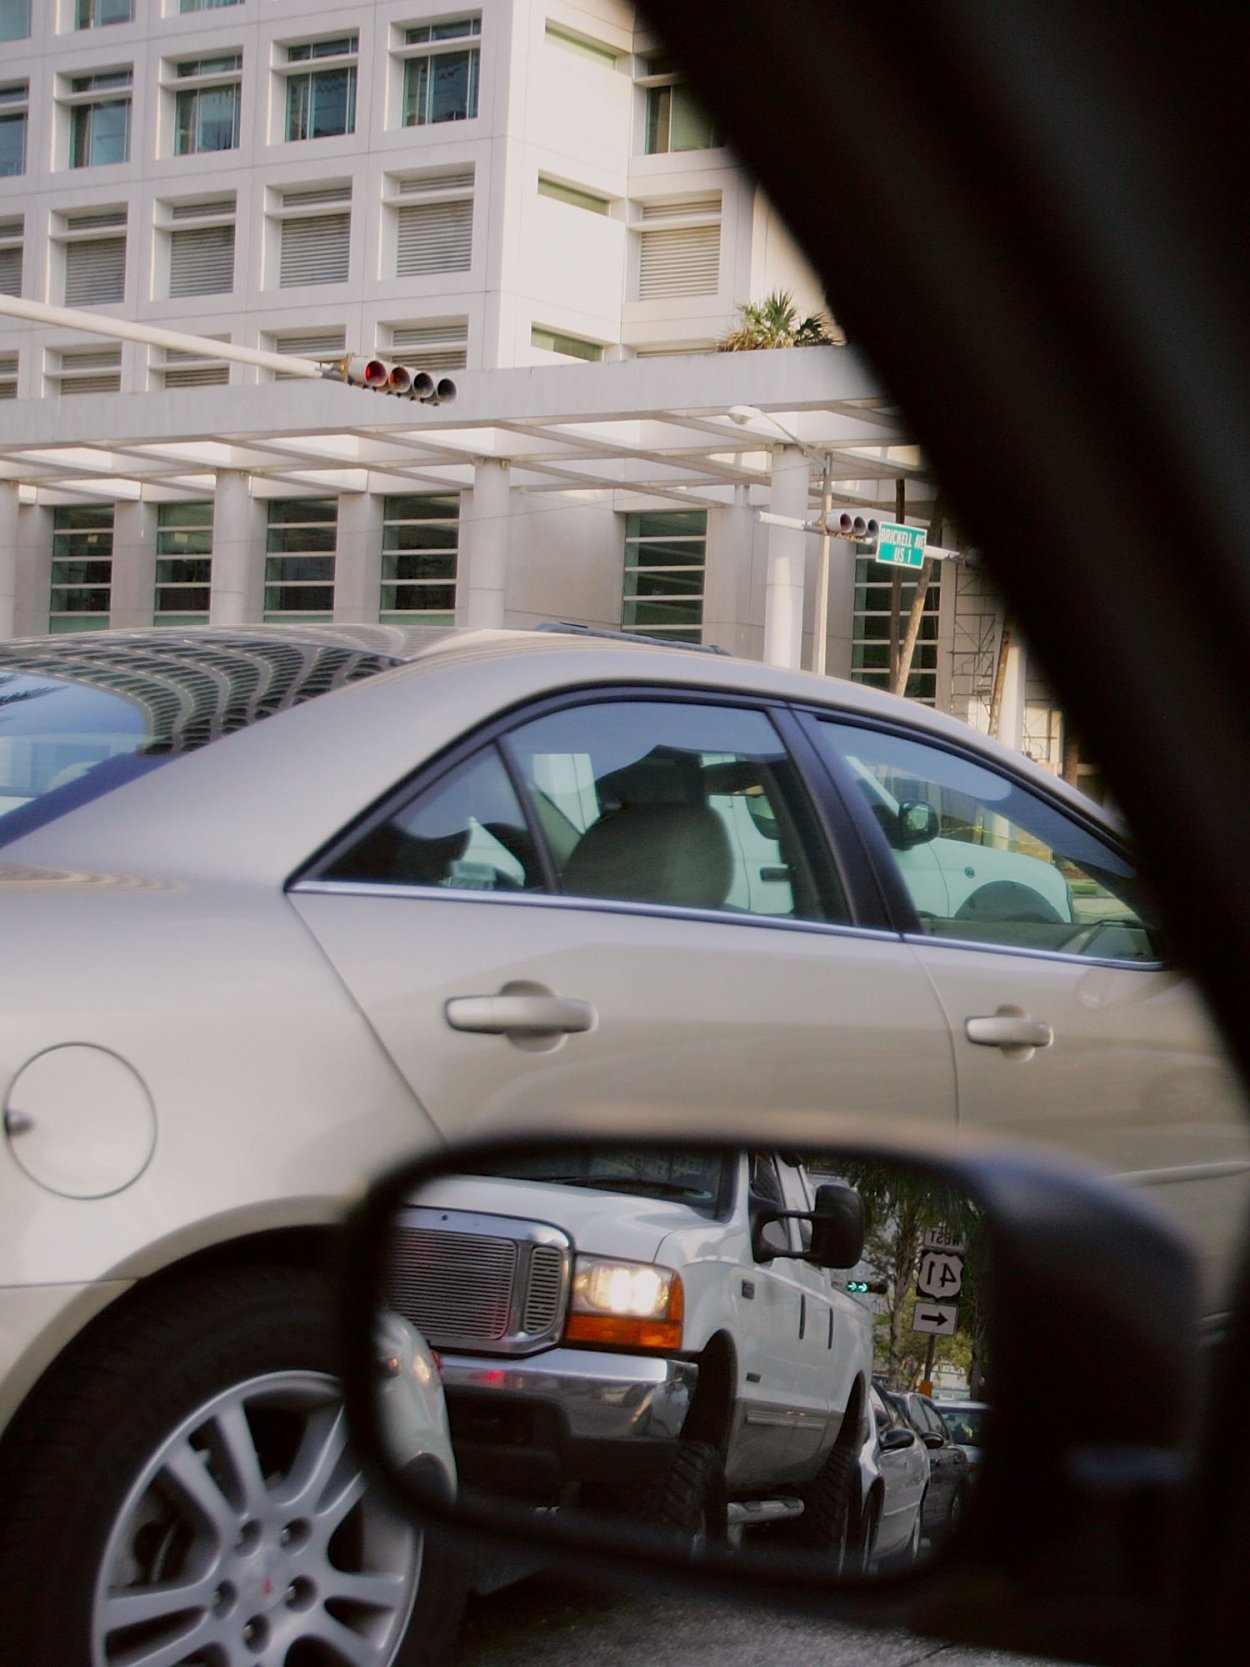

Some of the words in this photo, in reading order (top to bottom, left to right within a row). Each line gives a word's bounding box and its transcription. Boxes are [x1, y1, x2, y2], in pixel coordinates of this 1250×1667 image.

[880, 528, 912, 547] BRICKELL
[894, 546, 905, 562] US
[907, 549, 912, 563] 1
